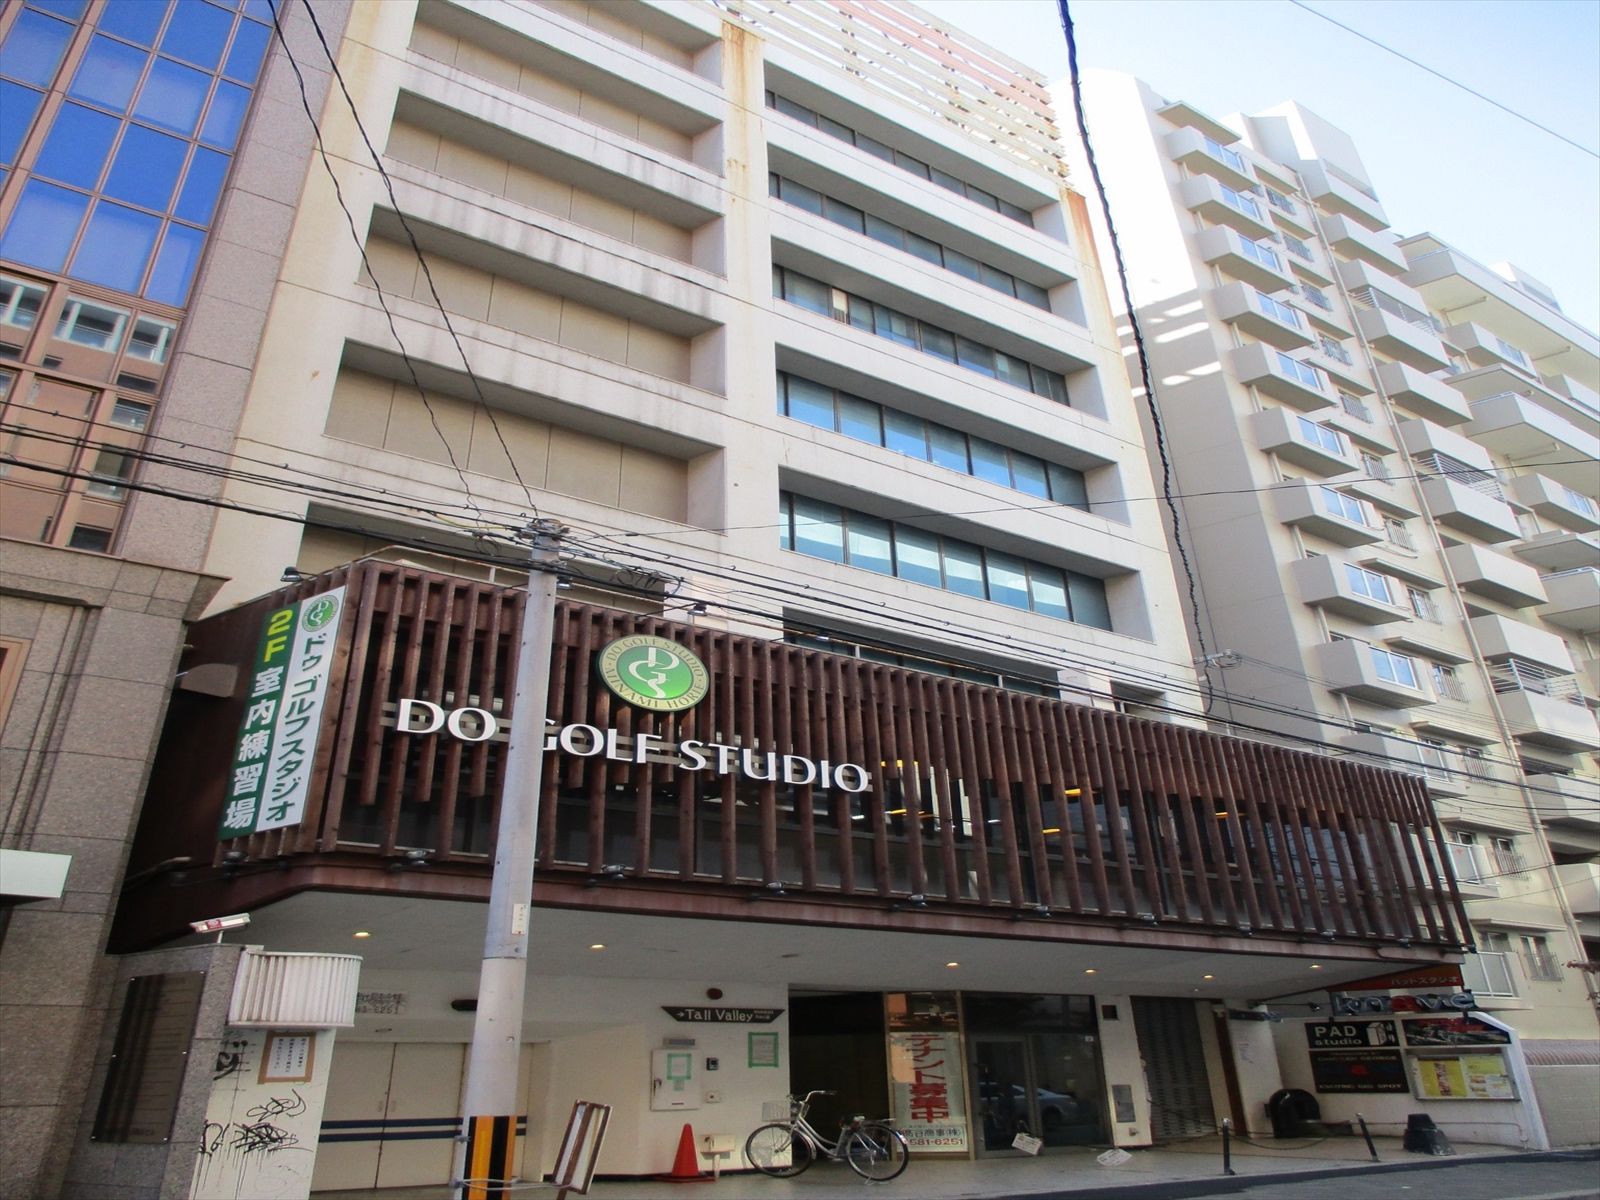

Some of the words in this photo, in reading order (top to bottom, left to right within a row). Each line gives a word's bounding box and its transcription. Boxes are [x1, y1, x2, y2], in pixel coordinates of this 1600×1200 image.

[264, 609, 293, 663] 2F
[223, 665, 284, 829] 室内練習場
[396, 698, 497, 742] DO
[678, 740, 869, 793] STUDIO
[684, 1008, 711, 1021] Tall
[716, 1008, 753, 1022] Valley
[1315, 1025, 1357, 1038] PAD
[1314, 1037, 1363, 1046] studio
